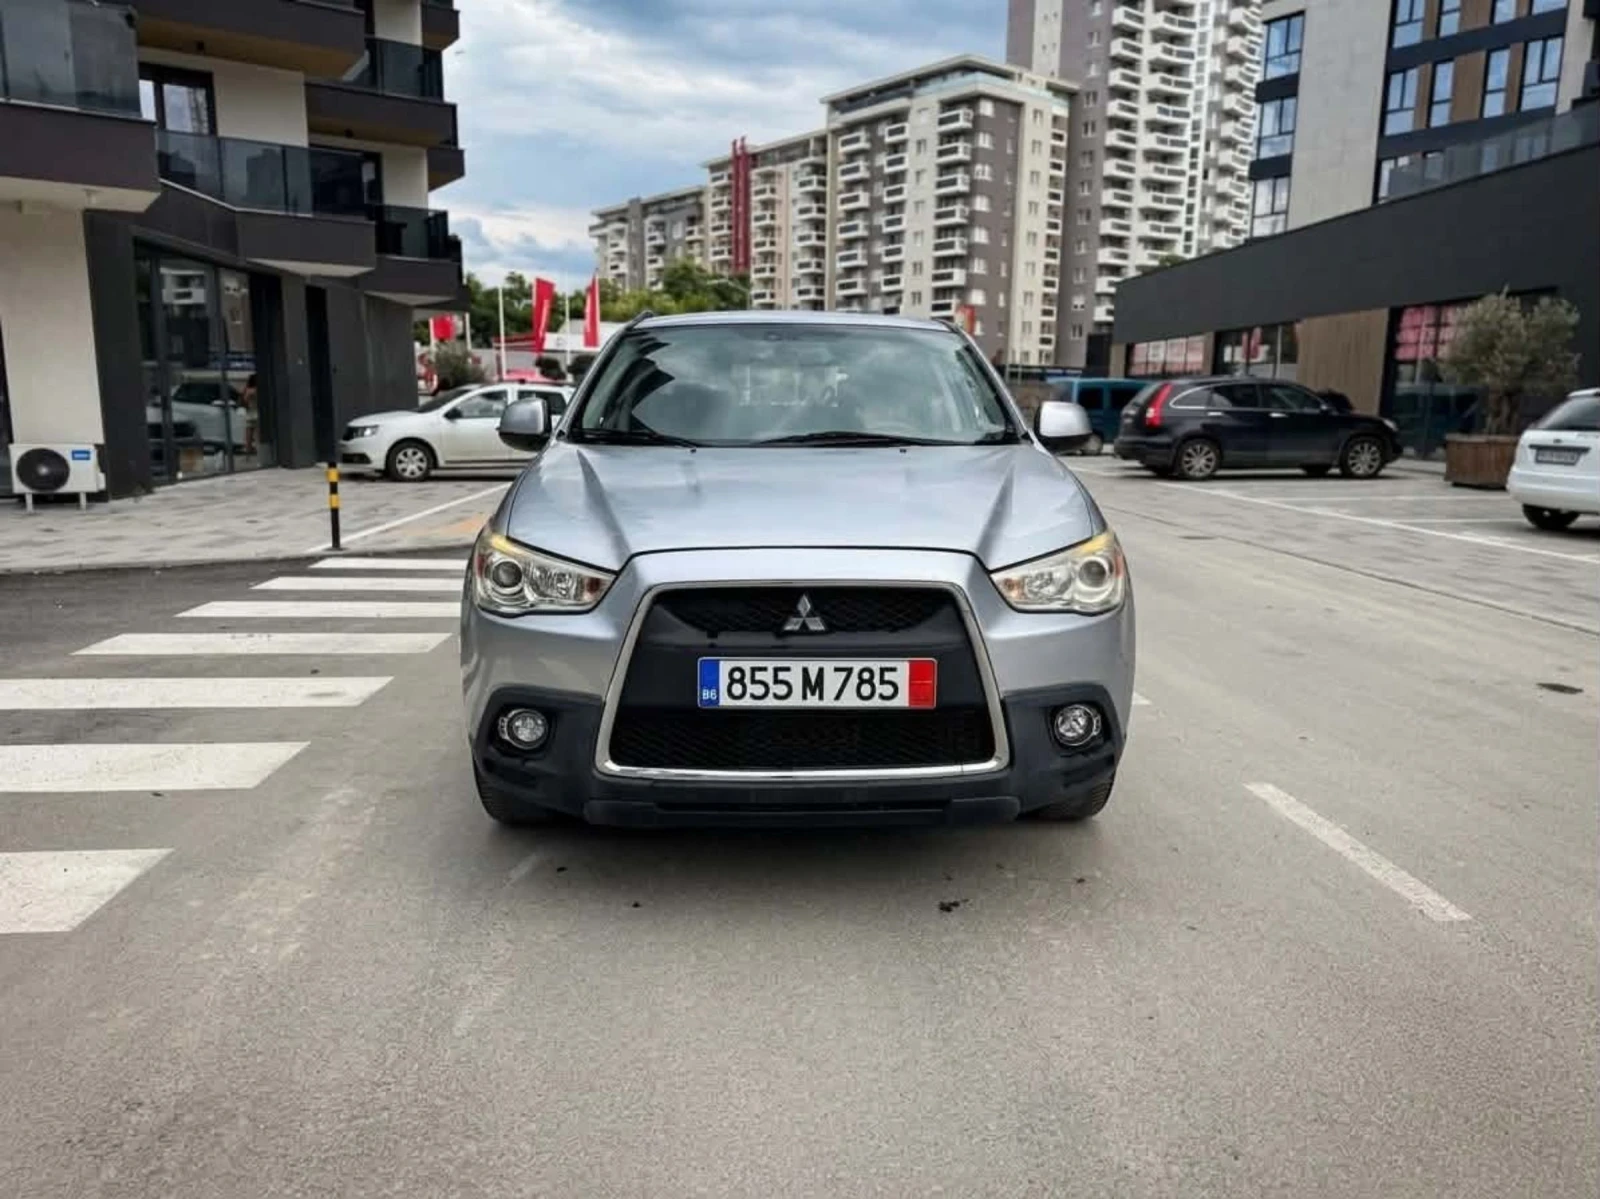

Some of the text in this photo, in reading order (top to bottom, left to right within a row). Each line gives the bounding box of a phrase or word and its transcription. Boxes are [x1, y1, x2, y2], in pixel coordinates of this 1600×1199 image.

[726, 666, 900, 701] 855 M 785
